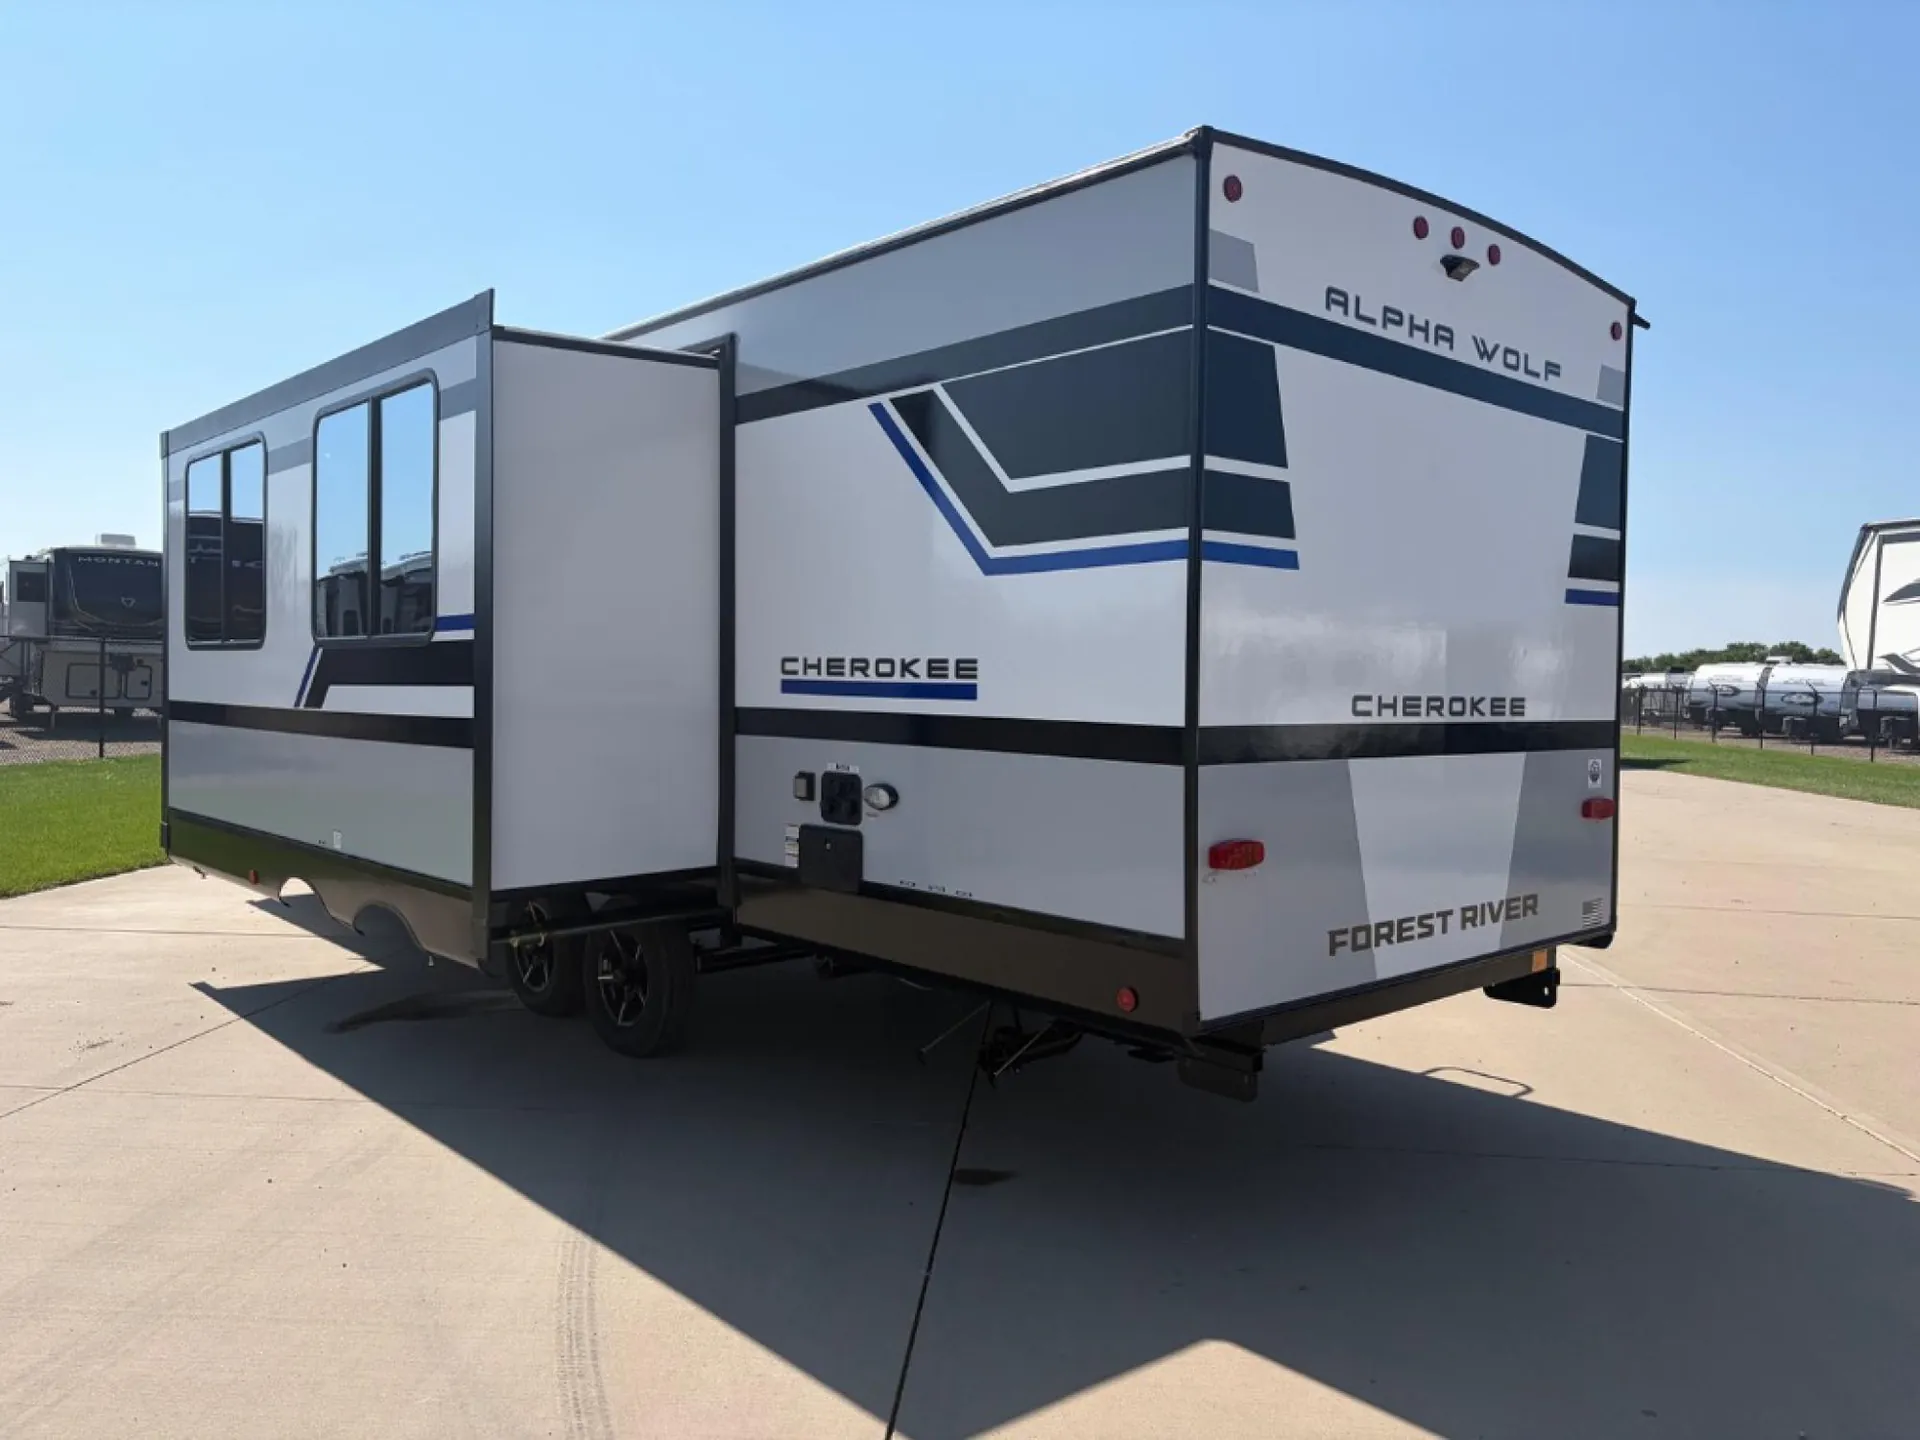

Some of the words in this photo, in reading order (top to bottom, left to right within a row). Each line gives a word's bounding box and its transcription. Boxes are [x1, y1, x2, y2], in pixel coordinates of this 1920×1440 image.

[1325, 286, 1454, 350] ALPHA
[1472, 335, 1561, 380] WOLF
[78, 556, 159, 567] MONTAN
[781, 657, 978, 679] CHEROKEE
[1351, 695, 1525, 717] CHEROKEE
[1328, 910, 1454, 956] FOREST
[1460, 894, 1538, 931] RIVER
